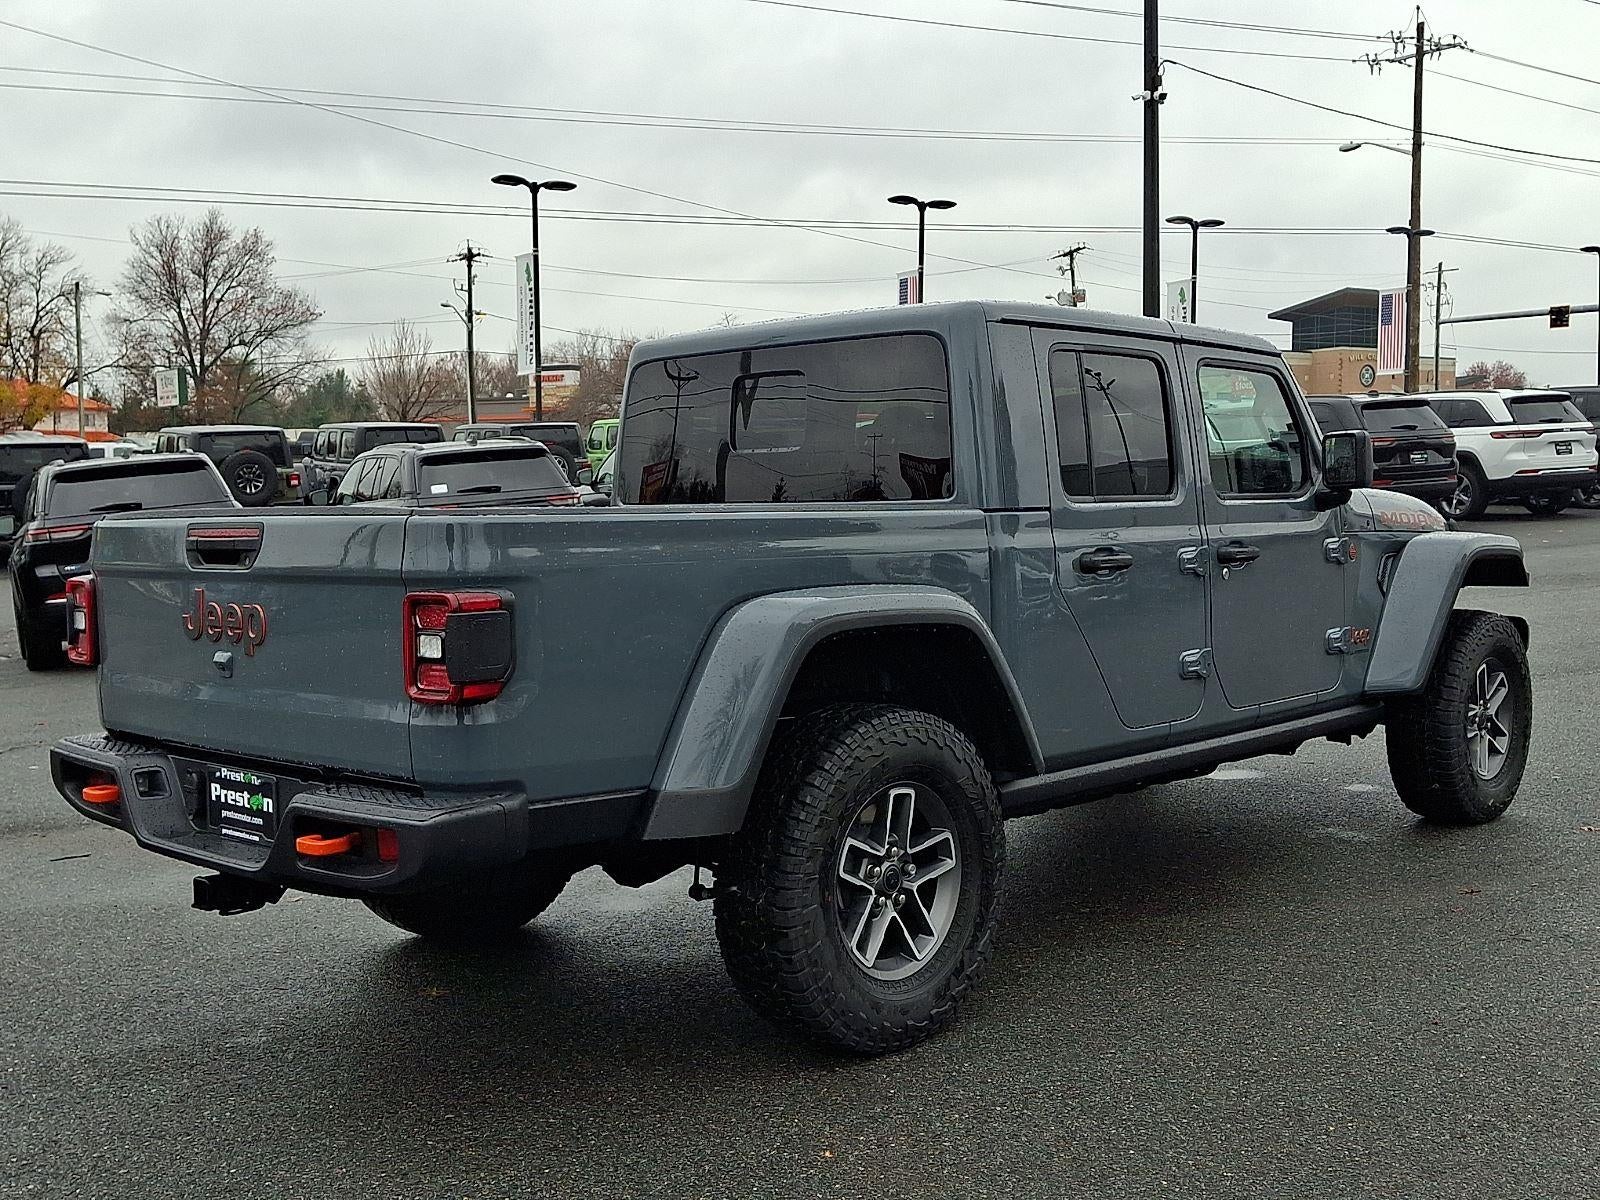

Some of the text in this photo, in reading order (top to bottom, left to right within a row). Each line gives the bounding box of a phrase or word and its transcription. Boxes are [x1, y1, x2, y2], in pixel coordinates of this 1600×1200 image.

[181, 587, 268, 657] Jeep
[221, 768, 258, 786] Preston
[210, 782, 274, 814] Preston
